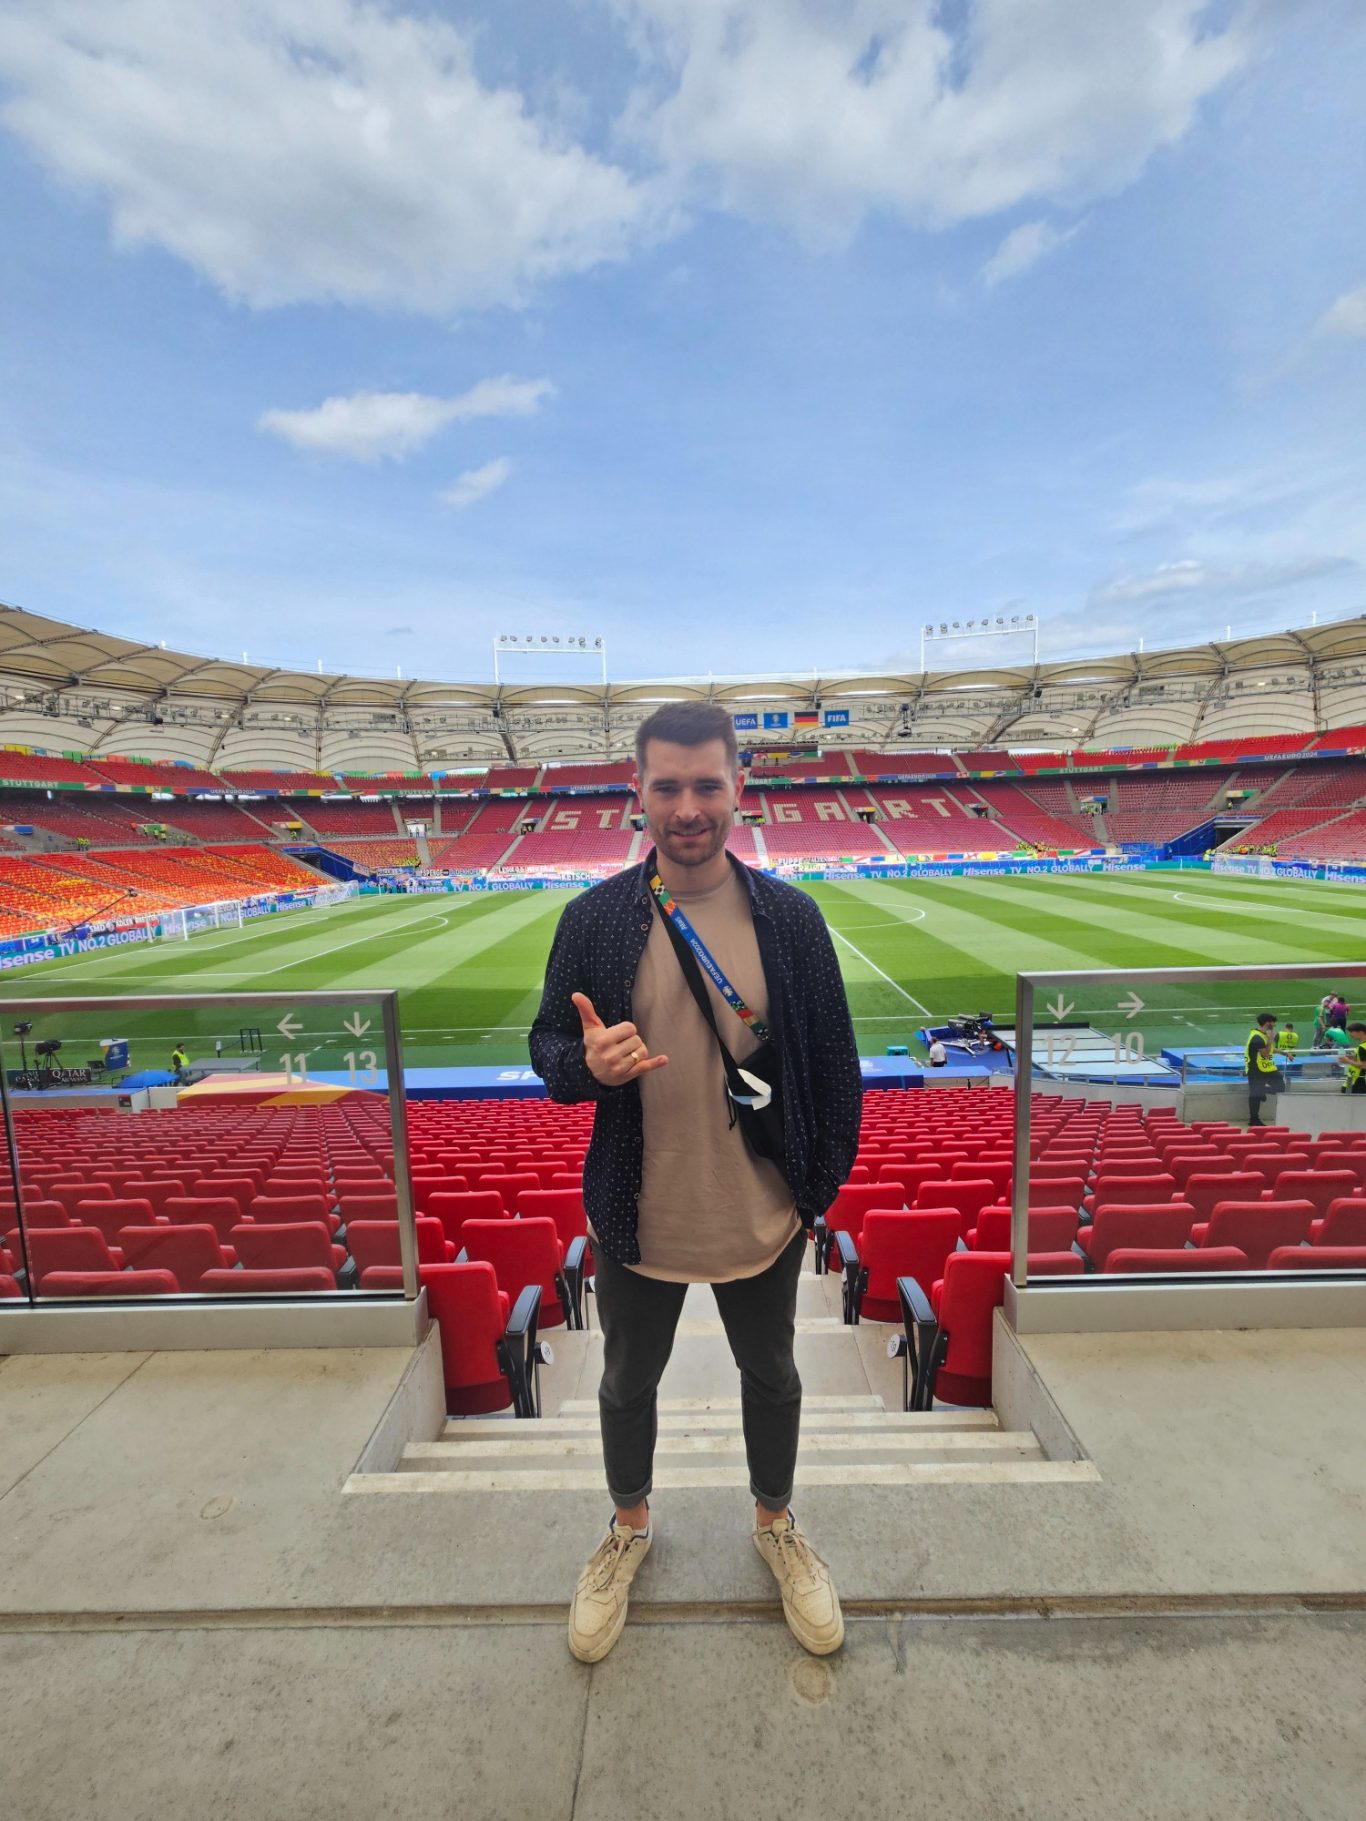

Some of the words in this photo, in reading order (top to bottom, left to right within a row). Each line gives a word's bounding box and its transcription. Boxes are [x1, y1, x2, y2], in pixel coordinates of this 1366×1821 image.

[735, 718, 757, 726] UEFA
[827, 714, 847, 722] FIFA
[2, 779, 59, 789] STUTTGART
[823, 871, 866, 881] Hisense
[871, 871, 882, 879] TV
[886, 869, 908, 878] NO.2
[911, 867, 954, 877] GLOBALLY
[962, 867, 1006, 877] Hisense
[1026, 866, 1048, 874] NO.2
[1051, 864, 1094, 873] GLOBALLY
[1101, 863, 1146, 872] Hisense
[1276, 866, 1319, 879] GLOBALLY
[453, 884, 464, 893] TV
[491, 881, 534, 891] GLOBALLY
[543, 879, 585, 890] Hisense
[275, 900, 307, 913] Hisense
[58, 942, 75, 957] TV
[78, 935, 106, 953] NO.2
[107, 926, 158, 946] GLOBALLY
[1043, 1034, 1077, 1067] 12
[1112, 1031, 1145, 1065] 10
[279, 1053, 307, 1085] 11
[343, 1050, 378, 1086] 13
